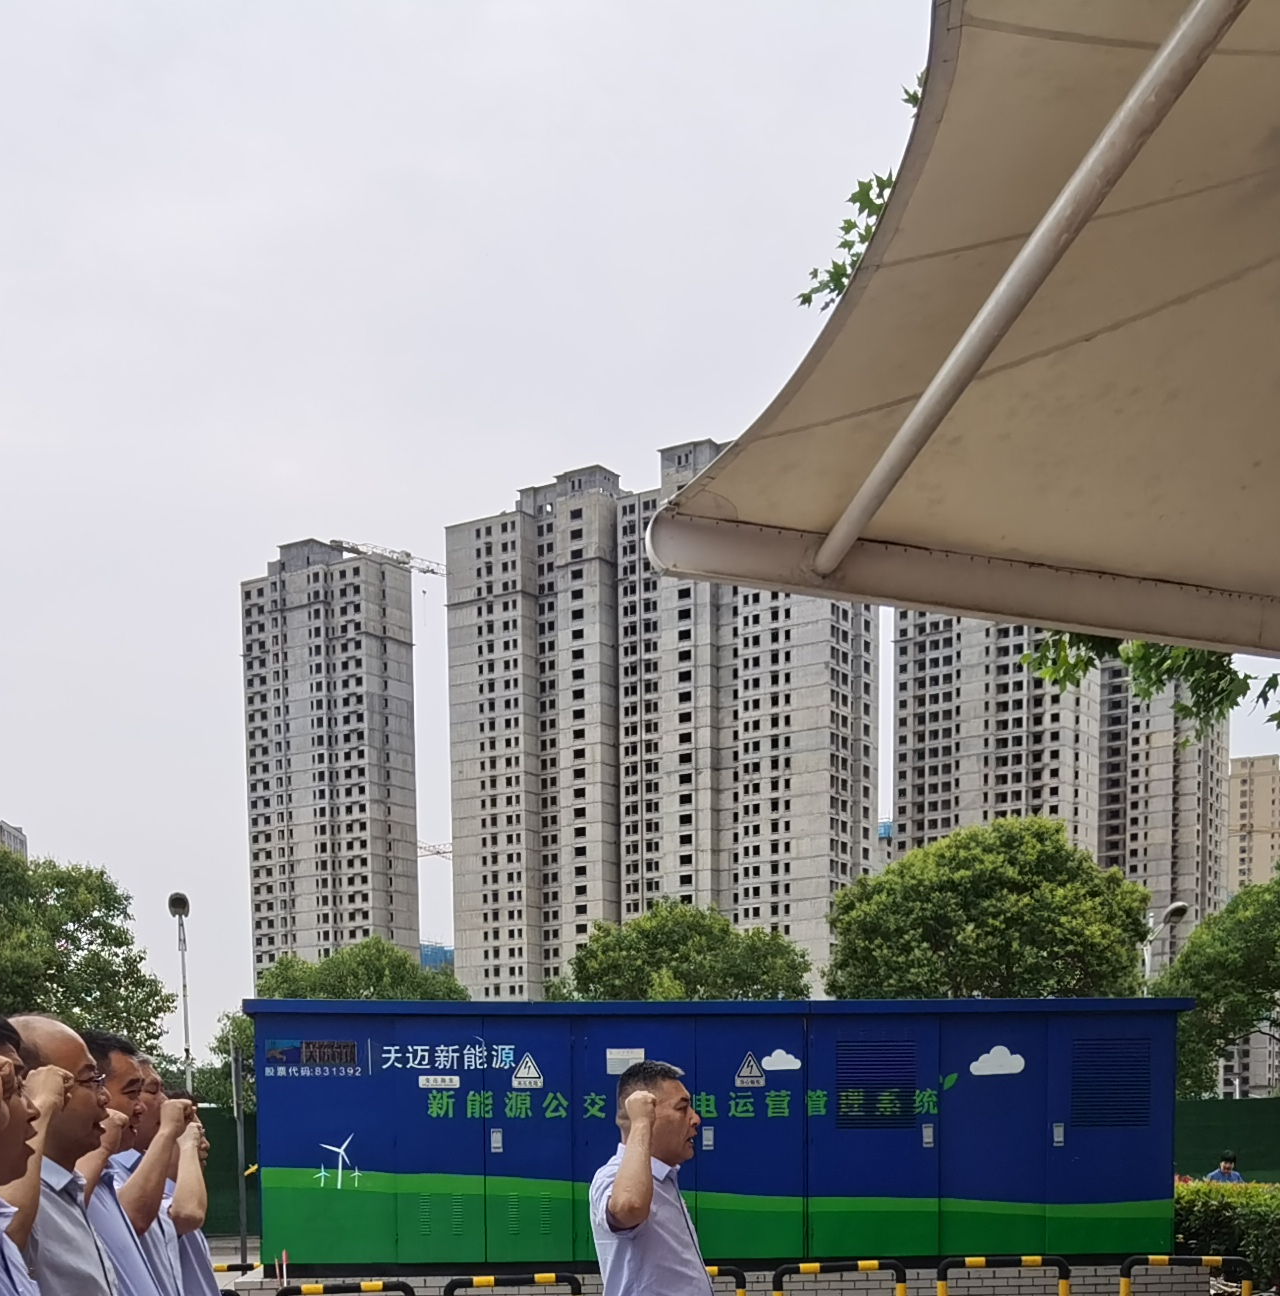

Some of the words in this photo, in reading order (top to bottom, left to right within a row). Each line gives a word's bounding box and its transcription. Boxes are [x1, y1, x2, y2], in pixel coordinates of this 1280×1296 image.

[381, 1044, 517, 1071] 天迈新能源
[264, 1066, 362, 1077] 股票代码:831392
